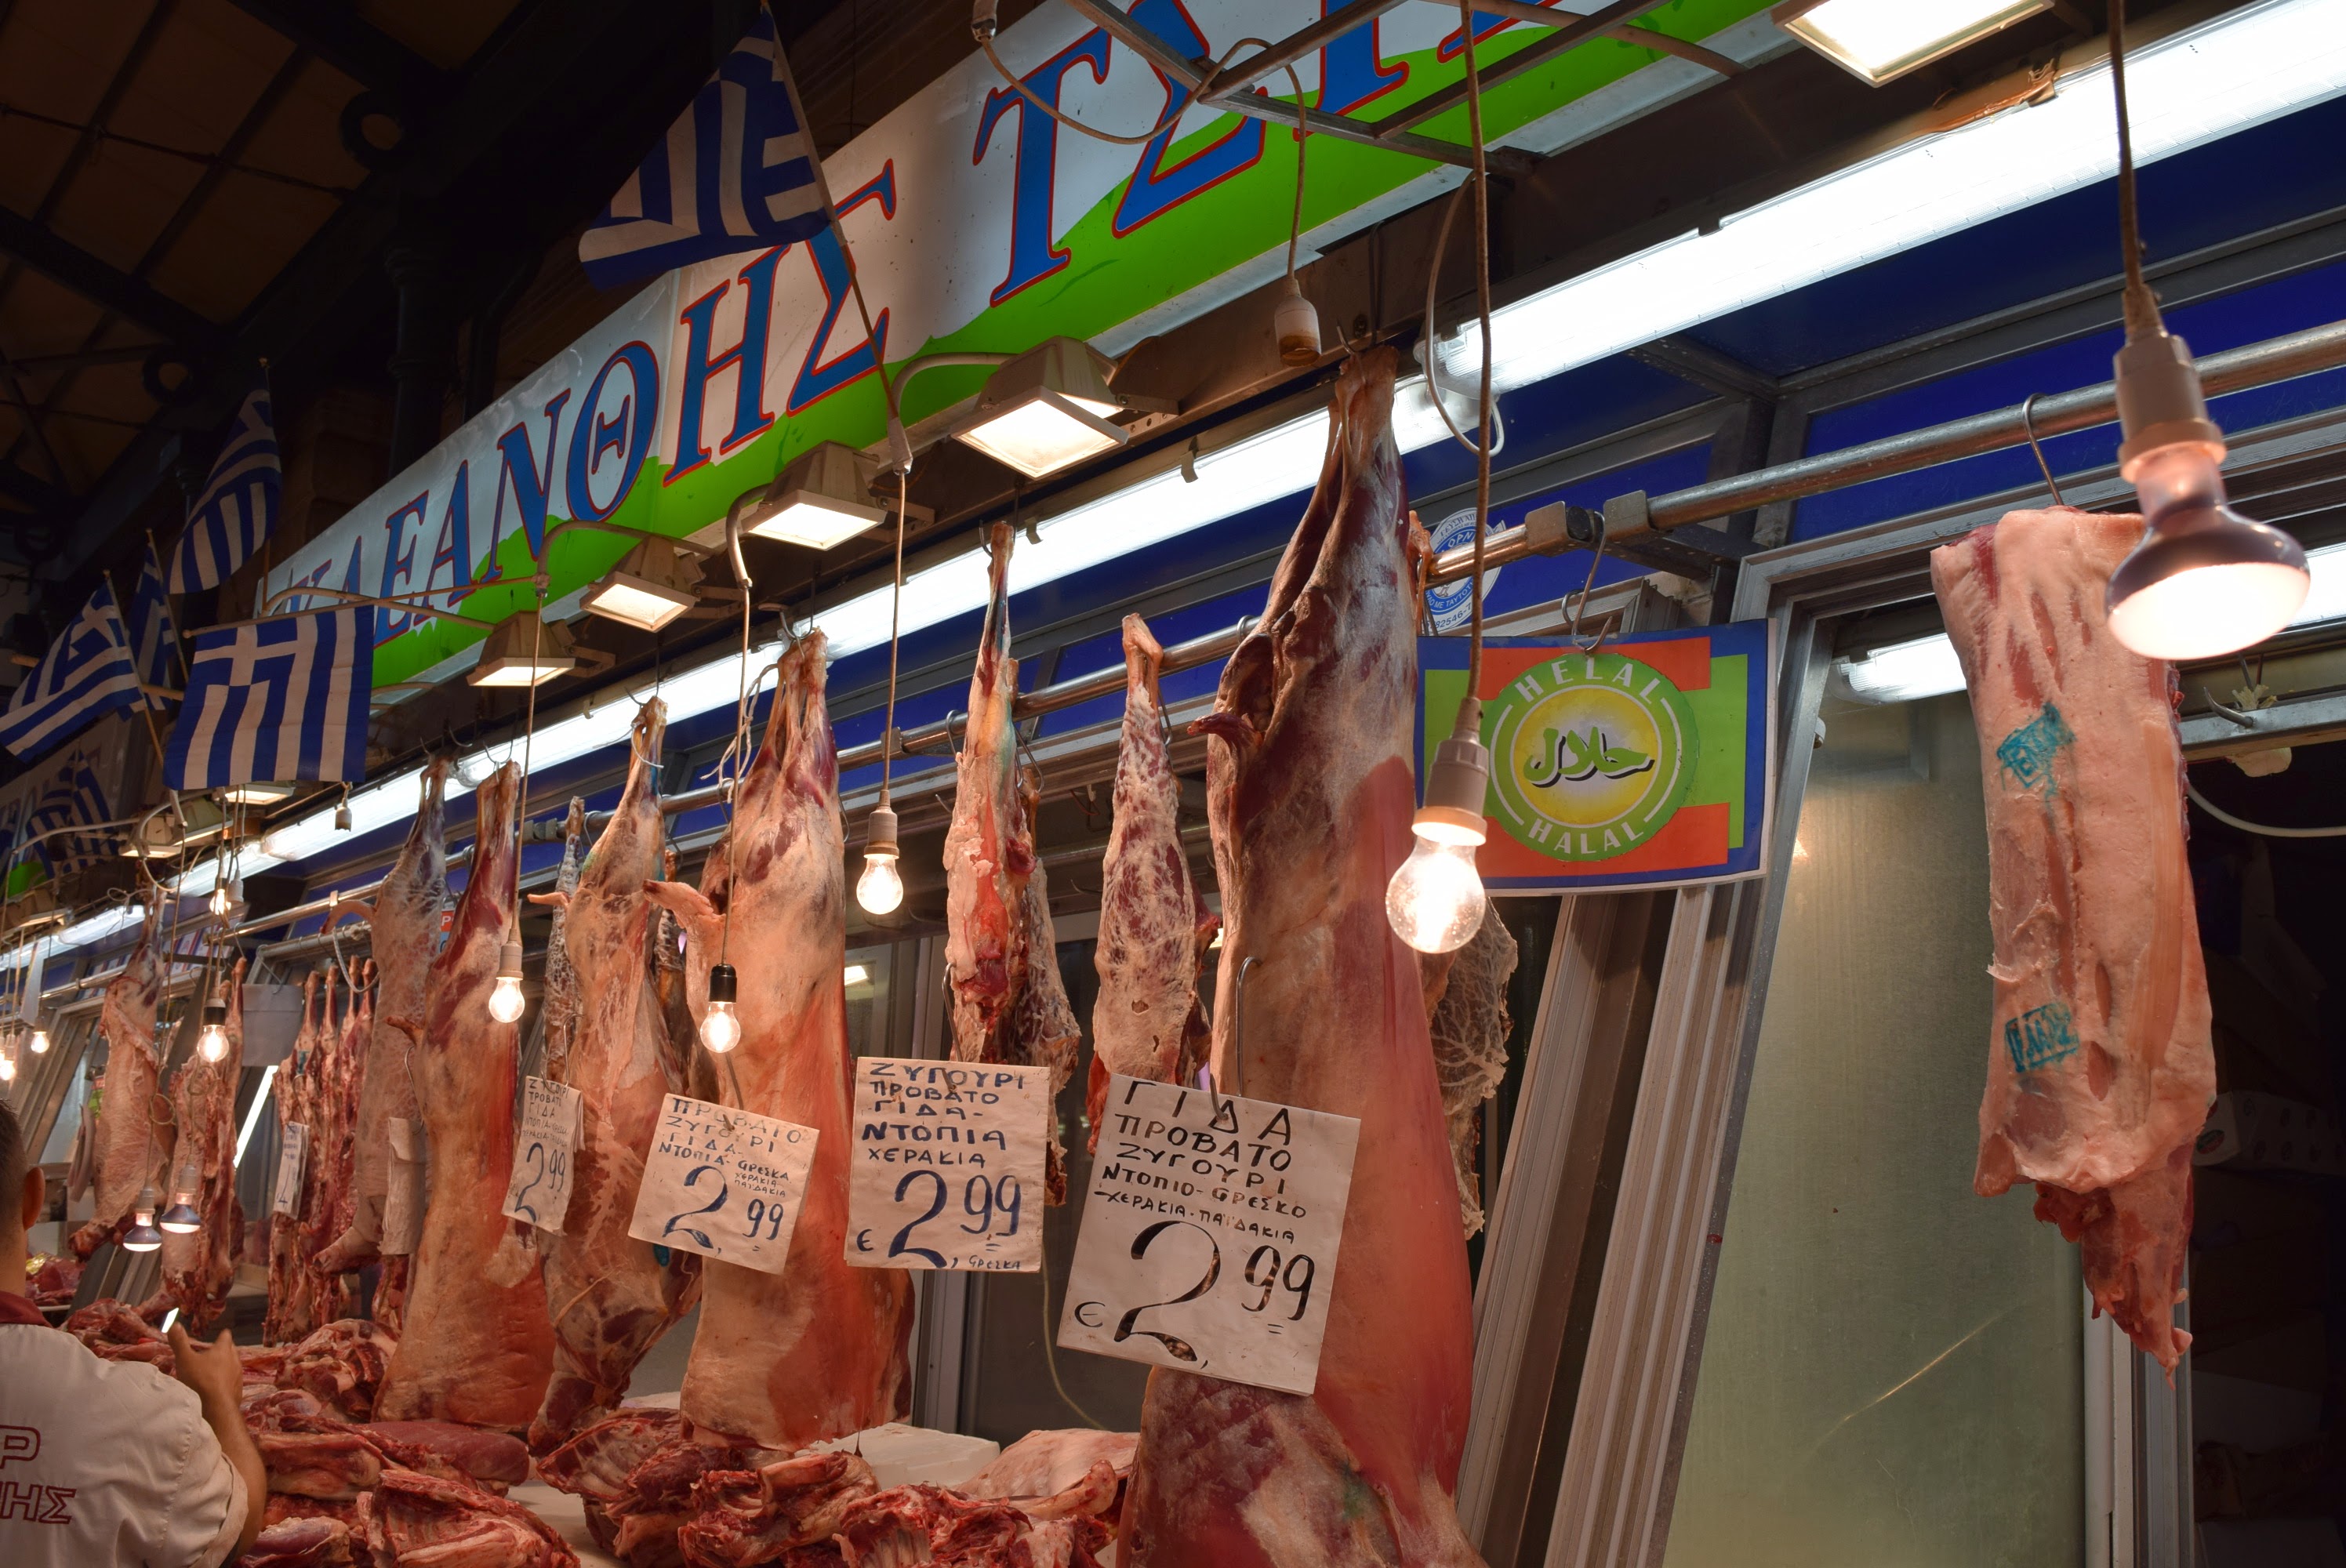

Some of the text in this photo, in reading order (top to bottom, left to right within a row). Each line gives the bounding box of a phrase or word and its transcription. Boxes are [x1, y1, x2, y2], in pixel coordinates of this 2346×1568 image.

[1446, 582, 1473, 608] ΤΑΥΤΟΤ
[1514, 656, 1661, 704] HELAL
[1523, 727, 1655, 788] حلال
[1528, 817, 1644, 855] HALAL
[869, 1062, 1023, 1089] ΖΥΓΟΥΡΙ
[870, 1080, 1000, 1104] ΠΡΟΒΑΤΟ
[528, 1102, 555, 1118] ΓΙΔΑ
[673, 1098, 801, 1144] ΠΡΟΒΑΤΟ
[1124, 1080, 1291, 1146] ΓΙΔΑ
[666, 1116, 775, 1152] ΖΥΓΟΥΡΙ
[862, 1121, 1006, 1151] ΝΤΟΠΙΑ
[1114, 1113, 1292, 1172] ΠΡΟΒΑΤΟ
[868, 1147, 986, 1169] ΧΕΡΑΚΙΑ
[1116, 1142, 1285, 1195] ΖΥΓΟΥΡΙ
[0, 1481, 77, 1524] ΗΣ
